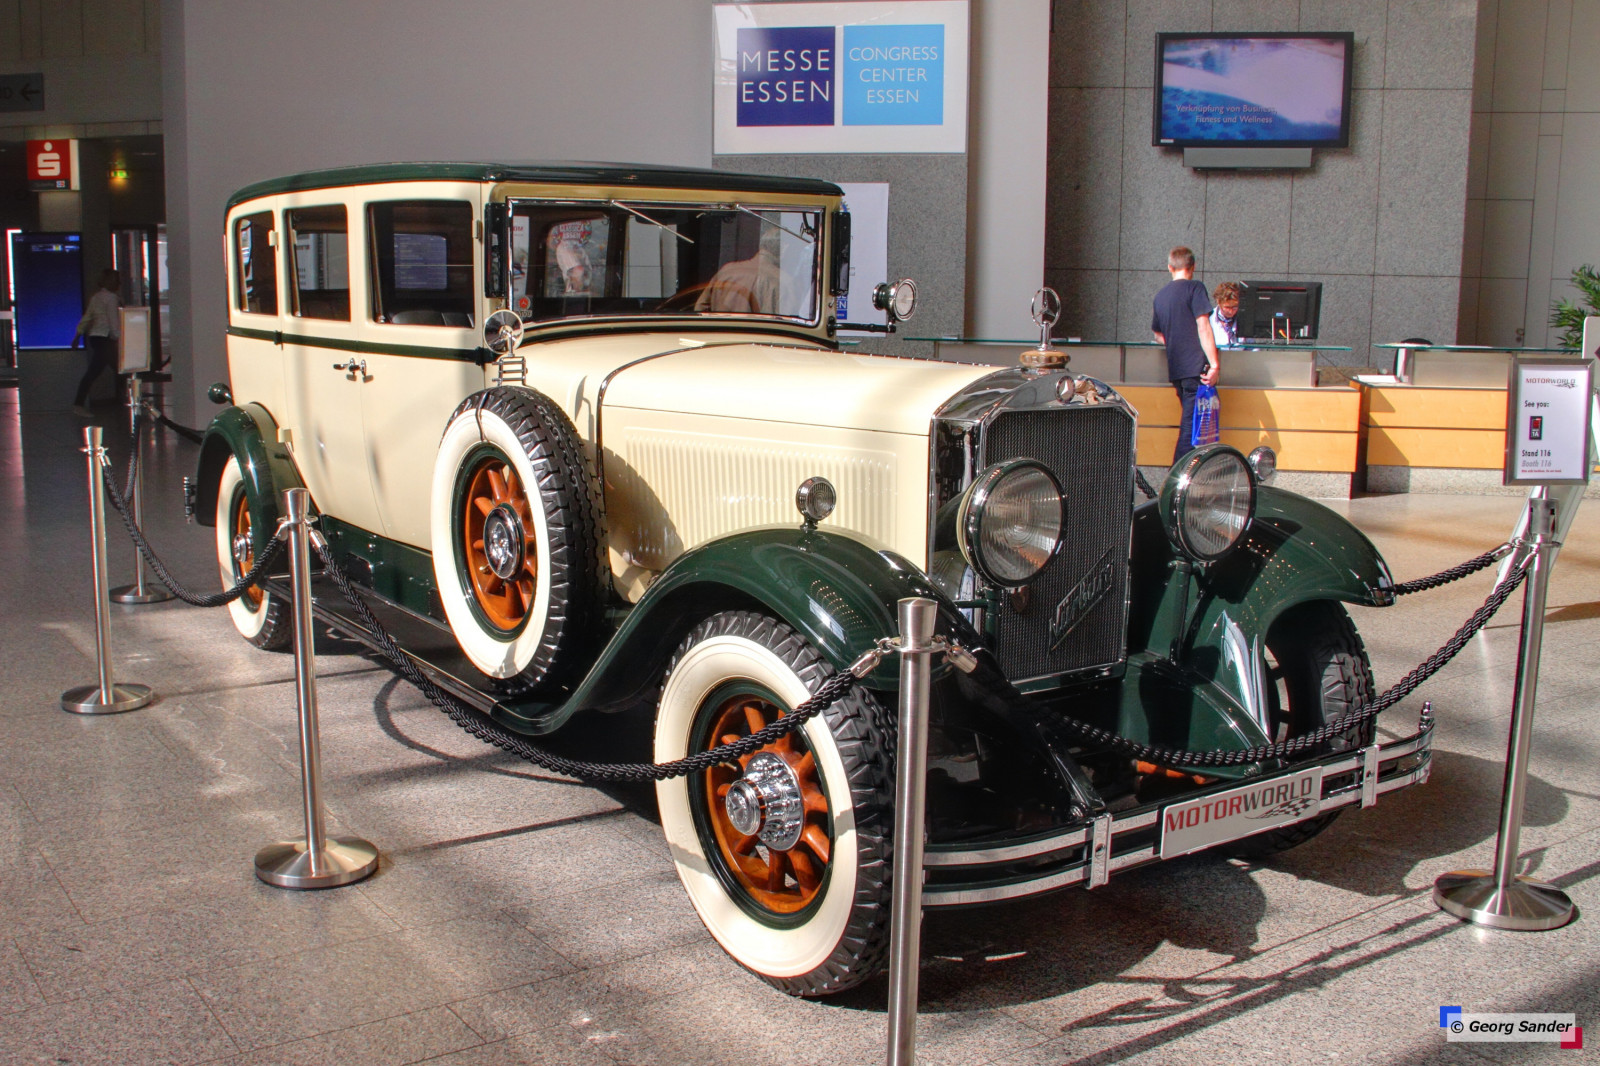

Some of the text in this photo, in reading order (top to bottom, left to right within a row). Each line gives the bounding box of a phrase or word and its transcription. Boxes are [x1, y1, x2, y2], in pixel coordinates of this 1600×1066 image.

[742, 49, 830, 72] MESSE
[849, 46, 938, 61] CONGRESS
[859, 67, 927, 82] CENTER
[742, 80, 830, 103] ESSEN
[867, 89, 919, 104] ESSEN
[1176, 104, 1224, 114] Verknüpfung
[1195, 115, 1273, 123] Fitness und Wellness
[1524, 400, 1535, 408] See
[1522, 449, 1551, 457] Stand 116
[1521, 459, 1552, 468] Booth 116
[1165, 776, 1313, 833] MOTORWORLD
